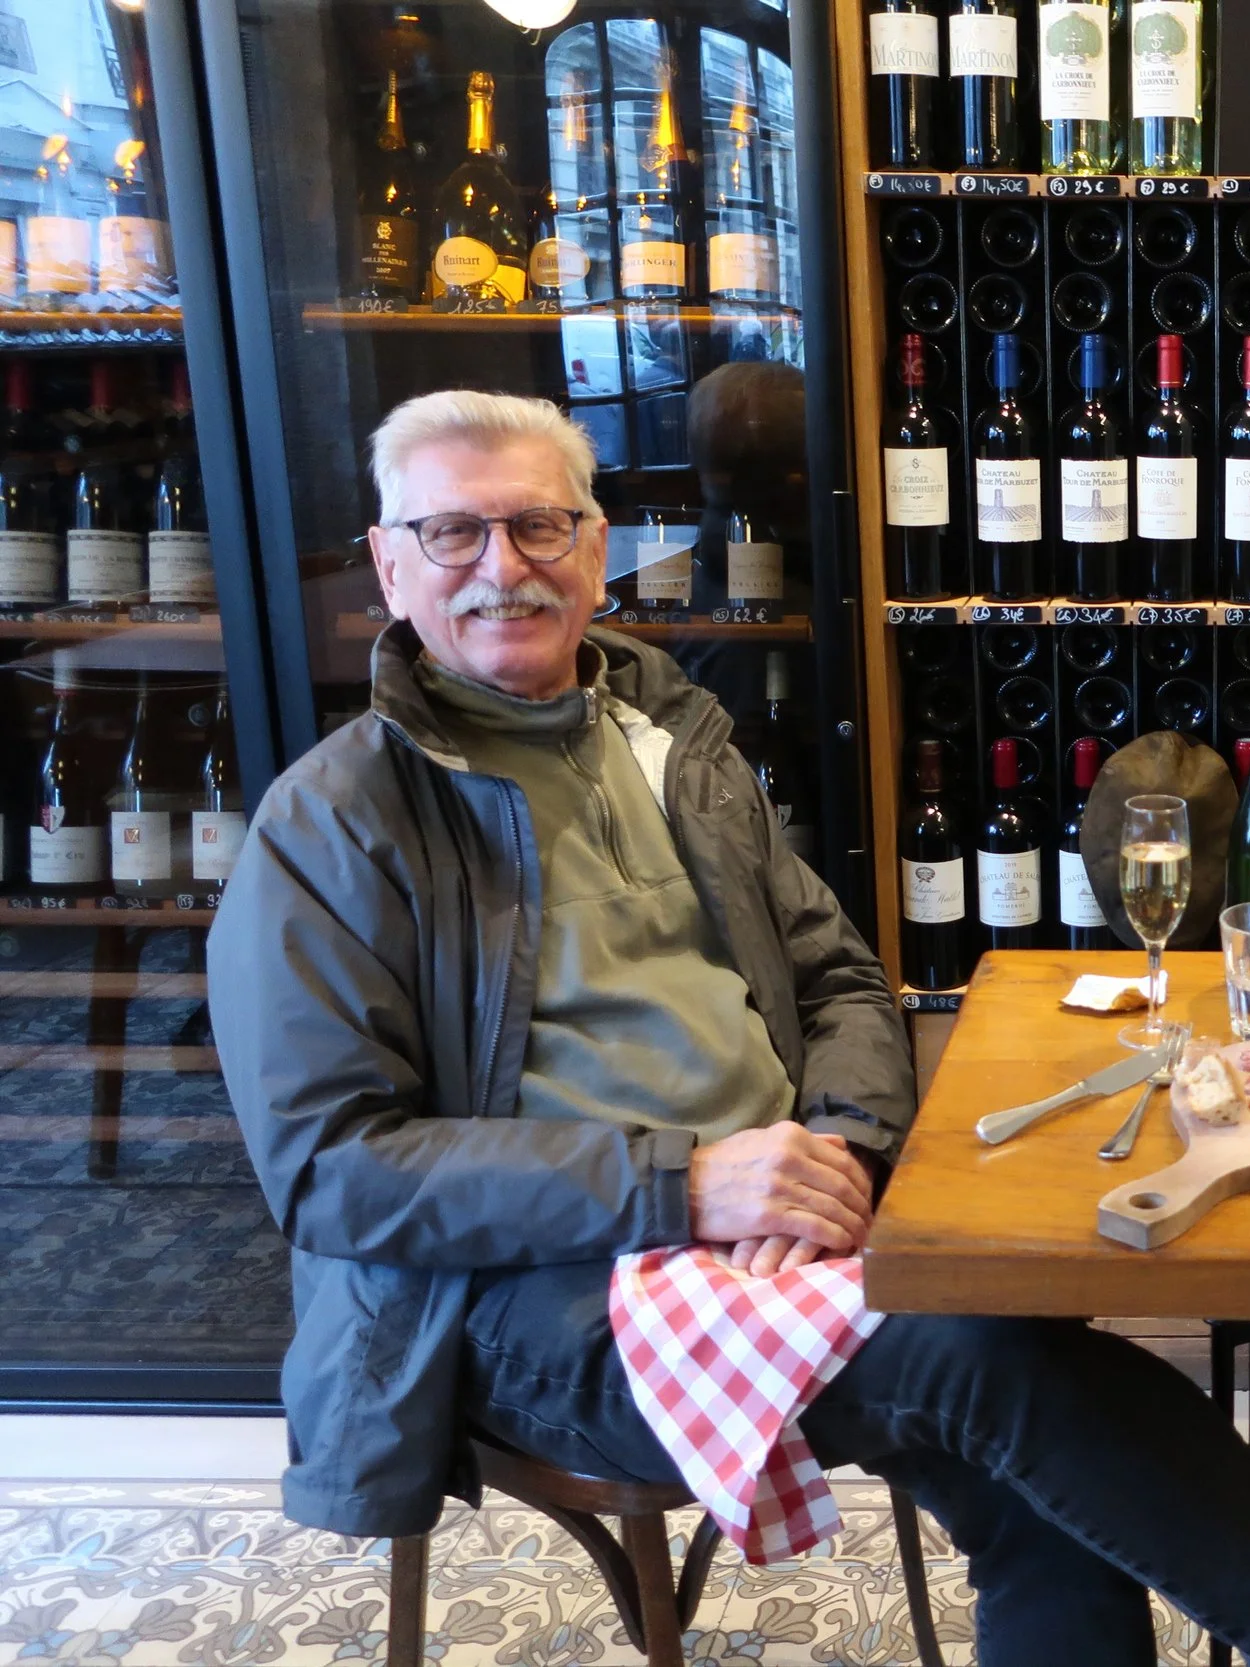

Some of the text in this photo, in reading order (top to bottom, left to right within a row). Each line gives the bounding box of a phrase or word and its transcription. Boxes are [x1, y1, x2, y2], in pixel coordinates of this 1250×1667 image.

[443, 254, 480, 266] Ruinart
[981, 468, 1021, 477] CHATEAU
[1076, 469, 1118, 477] CHATEAU
[1141, 474, 1184, 486] FONROQUE
